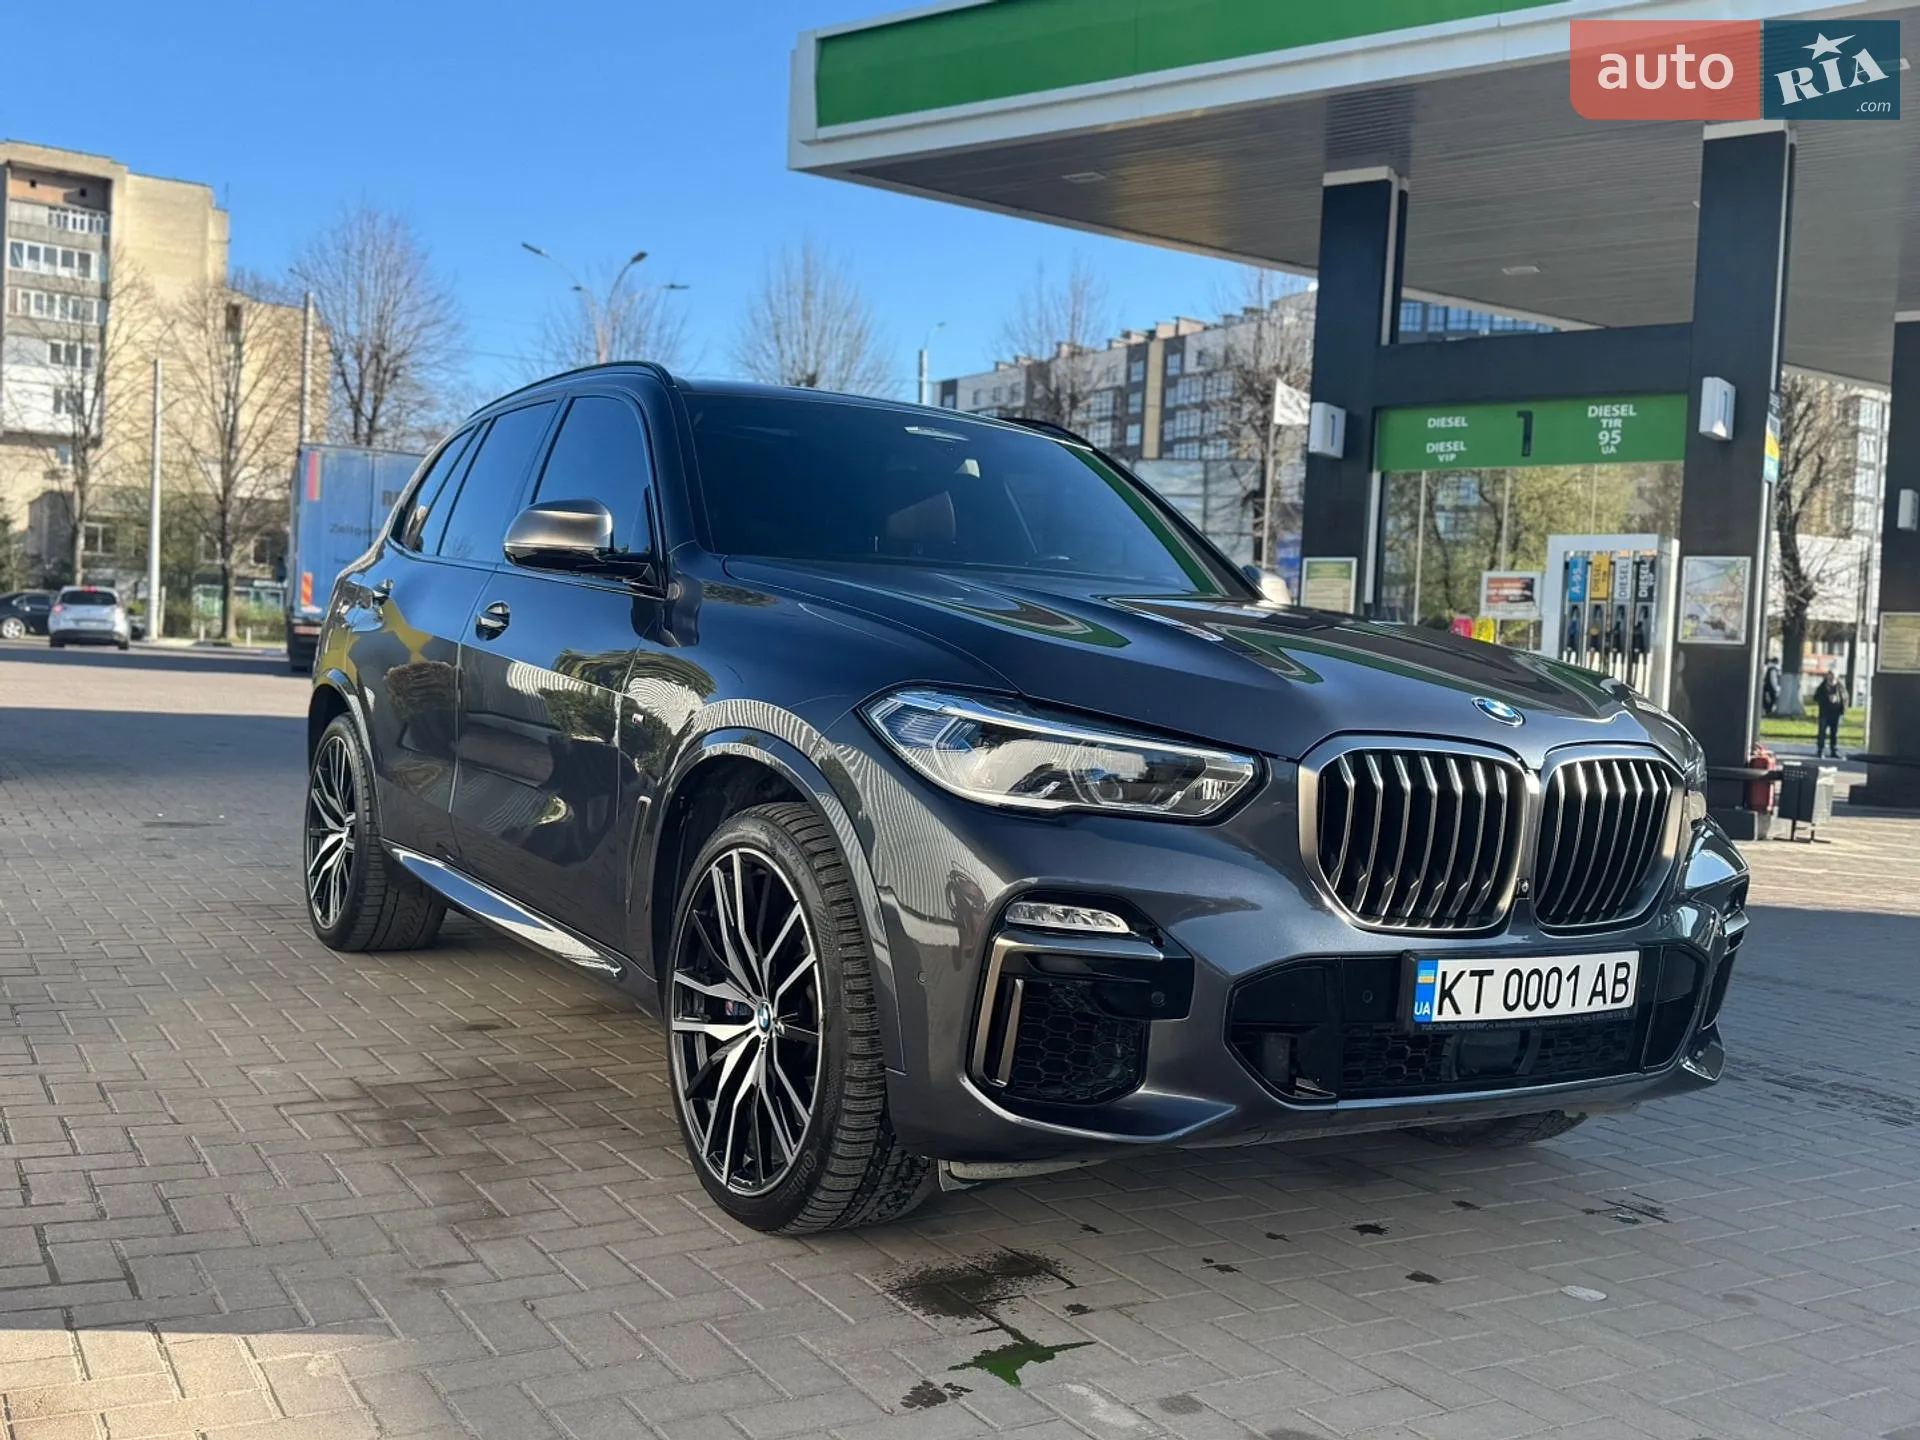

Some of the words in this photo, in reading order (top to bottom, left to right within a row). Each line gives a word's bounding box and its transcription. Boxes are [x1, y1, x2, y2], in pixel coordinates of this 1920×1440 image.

[1587, 404, 1637, 418] DIESEL
[1427, 416, 1468, 429] DIESEL
[1600, 419, 1622, 429] TIR
[1516, 410, 1534, 457] 1
[1598, 430, 1621, 445] 95
[1426, 441, 1467, 454] DIESEL
[1601, 445, 1617, 455] UA
[1437, 453, 1457, 463] VIP
[1619, 562, 1629, 598] DIESEL
[1639, 563, 1650, 598] DIESEL
[1437, 969, 1494, 1016] KT
[1502, 964, 1580, 1012] 0001
[1587, 961, 1631, 1006] AB
[1414, 1002, 1431, 1016] UA
